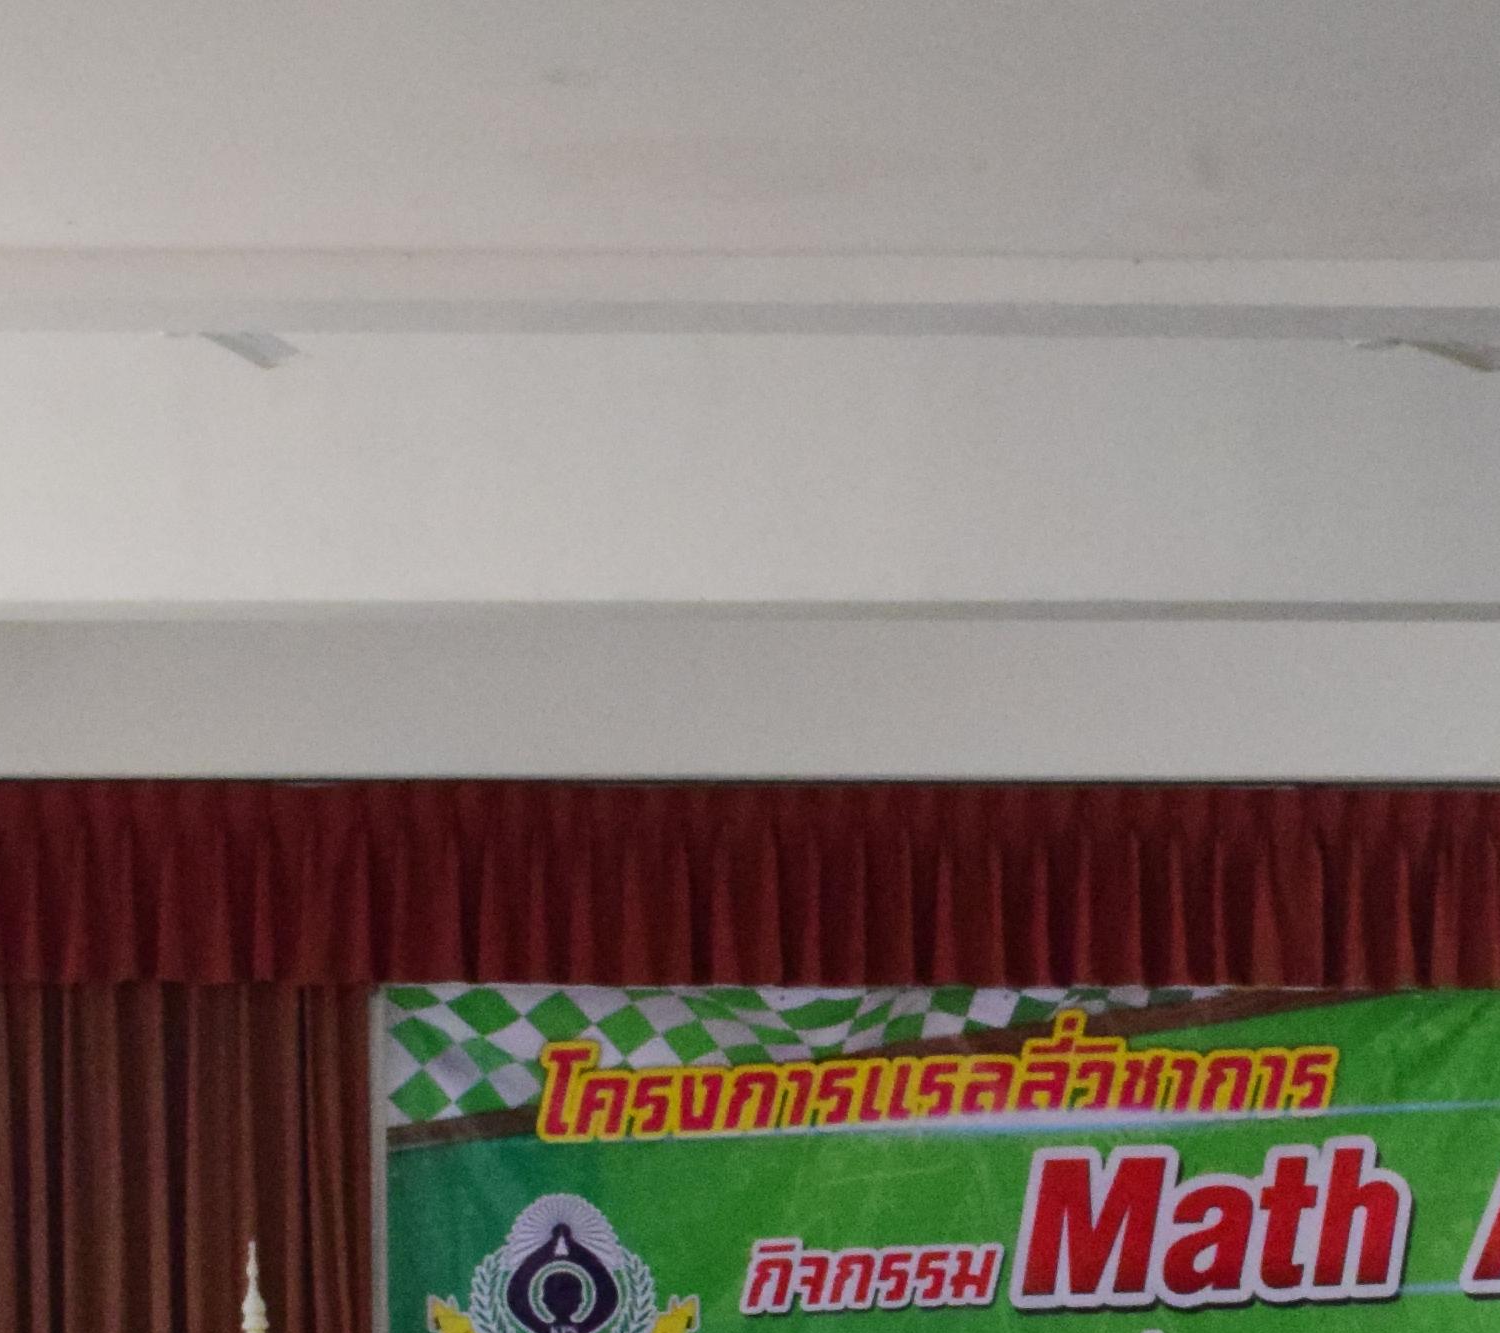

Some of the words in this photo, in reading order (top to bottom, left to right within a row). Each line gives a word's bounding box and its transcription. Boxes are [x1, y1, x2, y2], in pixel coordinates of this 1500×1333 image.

[741, 1238, 1002, 1312] กิจกรรม
[1016, 1140, 1406, 1304] Math
